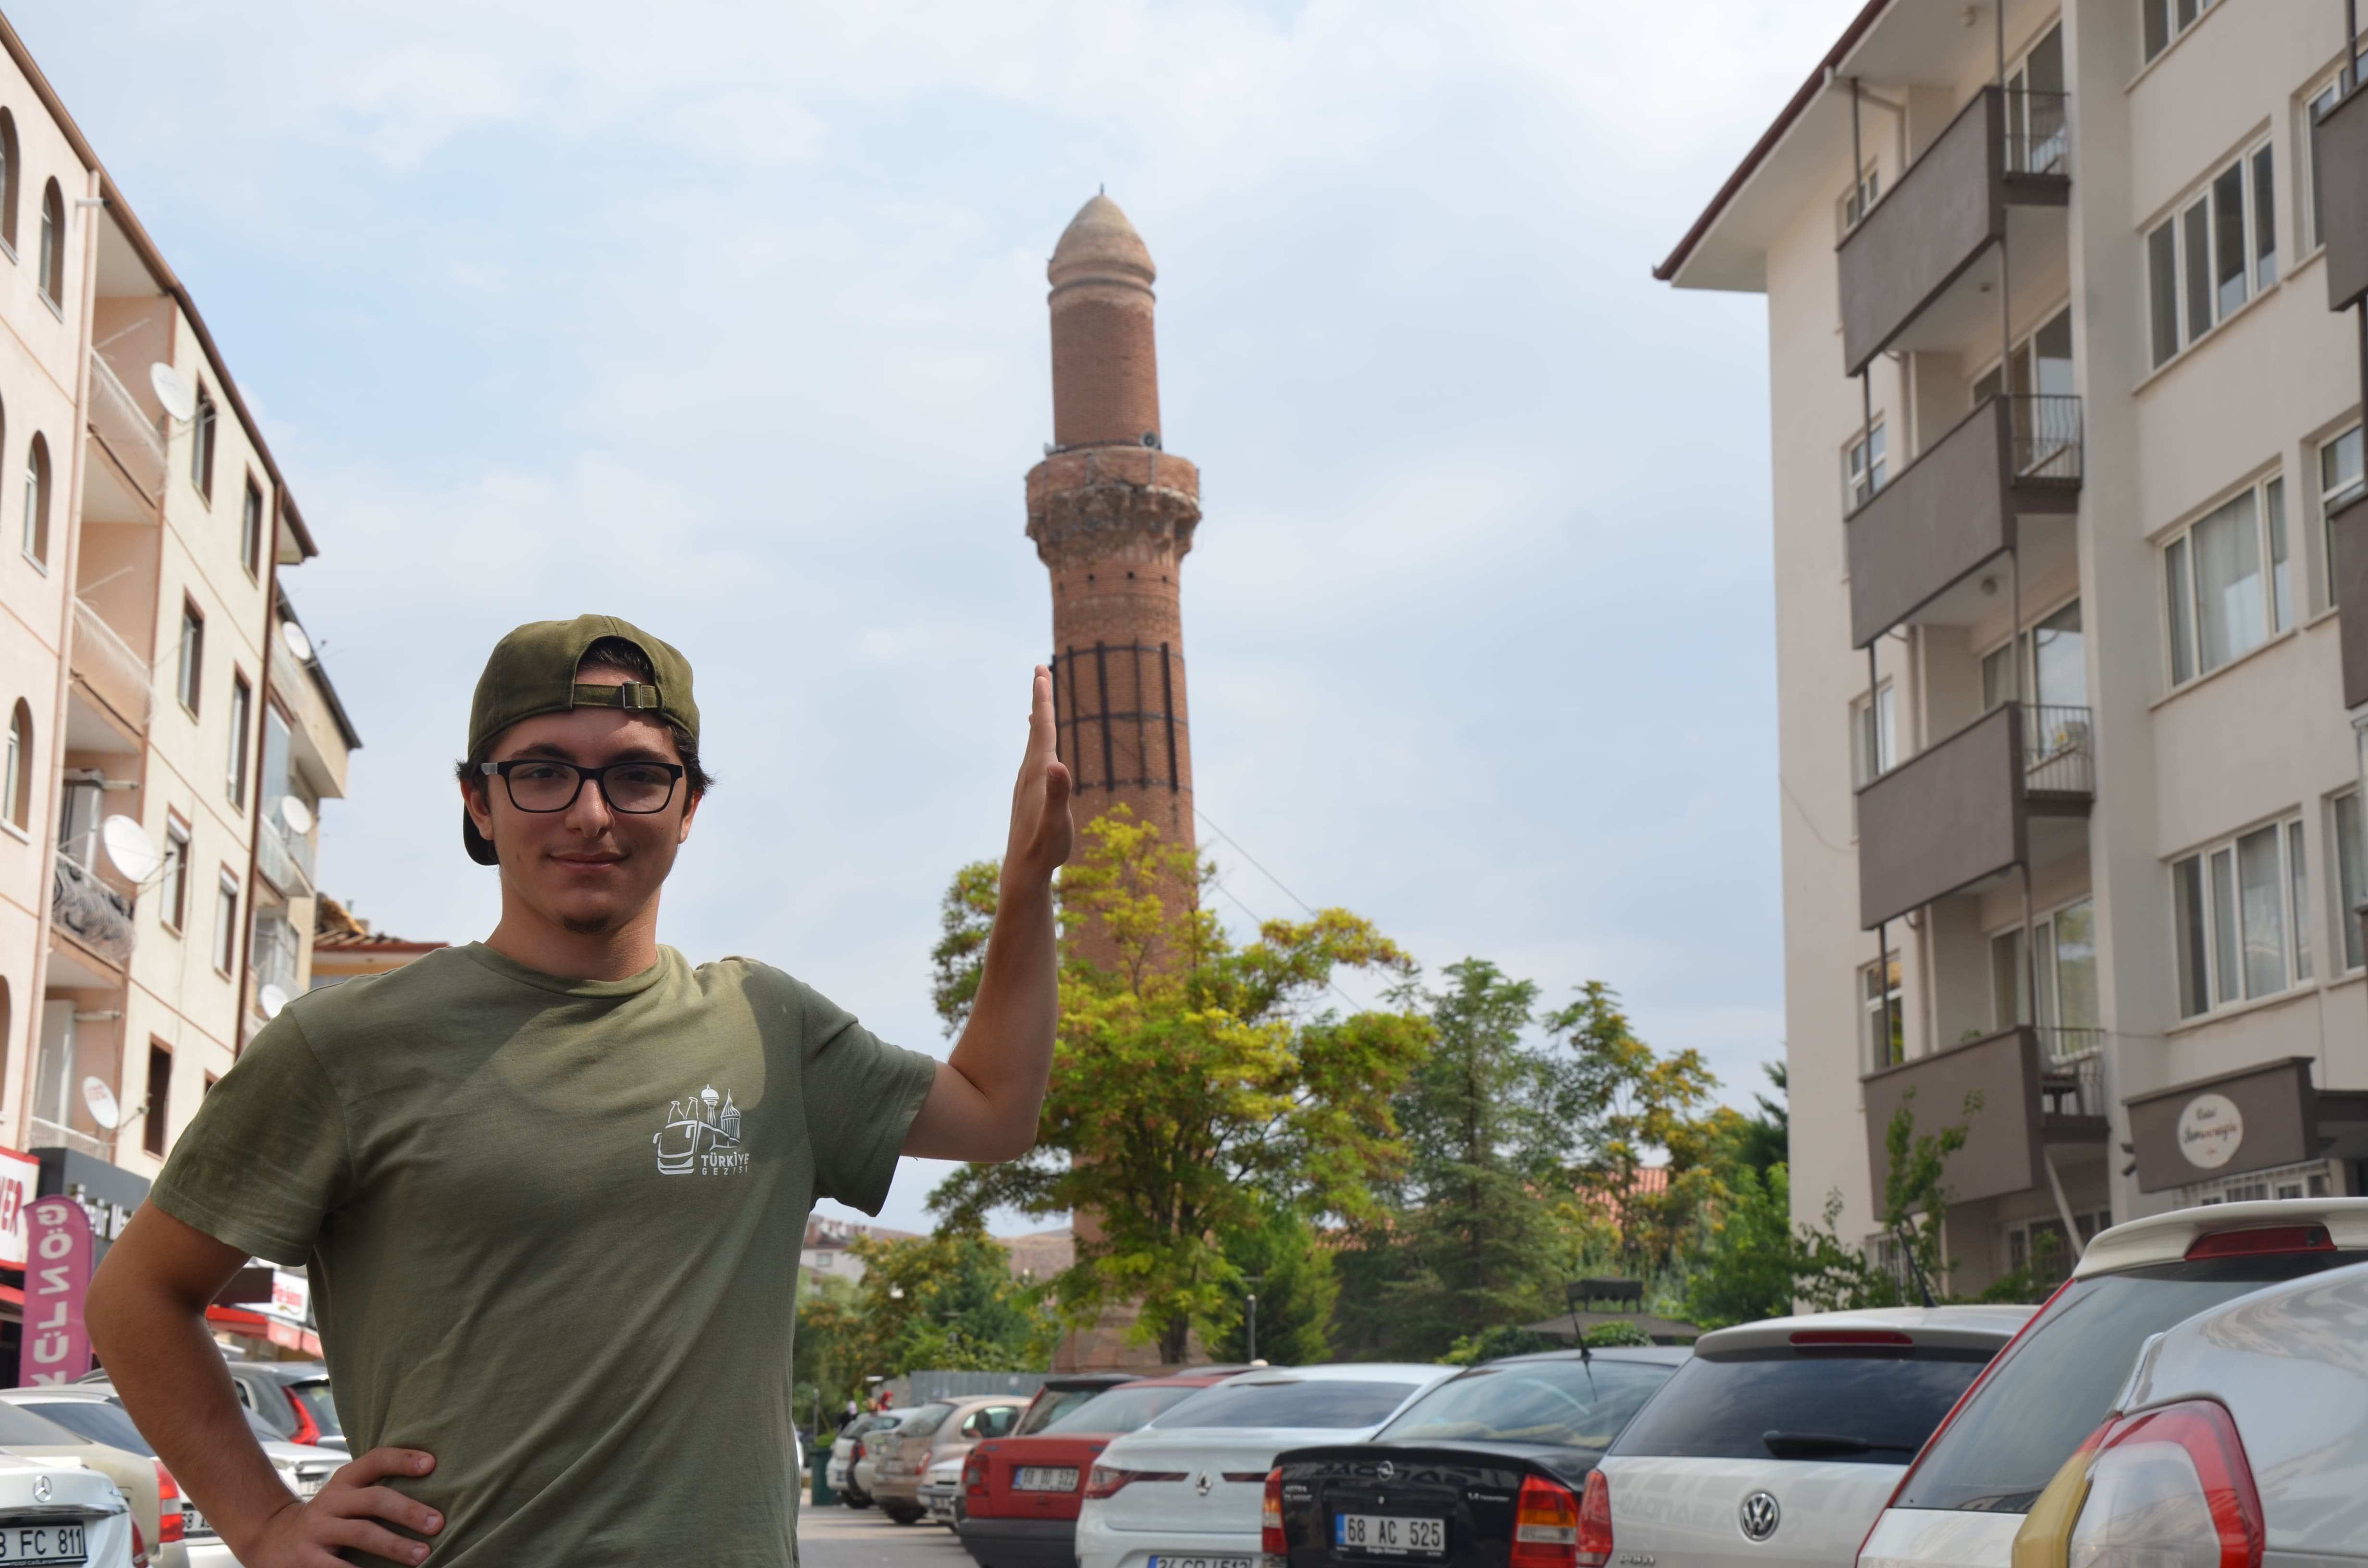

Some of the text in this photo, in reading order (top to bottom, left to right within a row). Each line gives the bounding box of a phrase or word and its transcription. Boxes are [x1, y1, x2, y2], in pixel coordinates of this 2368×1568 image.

[701, 1152, 750, 1167] TÜRKİYE
[20, 1530, 46, 1556] FC
[58, 1529, 82, 1555] 811
[1348, 1518, 1440, 1546] 68 AC 525
